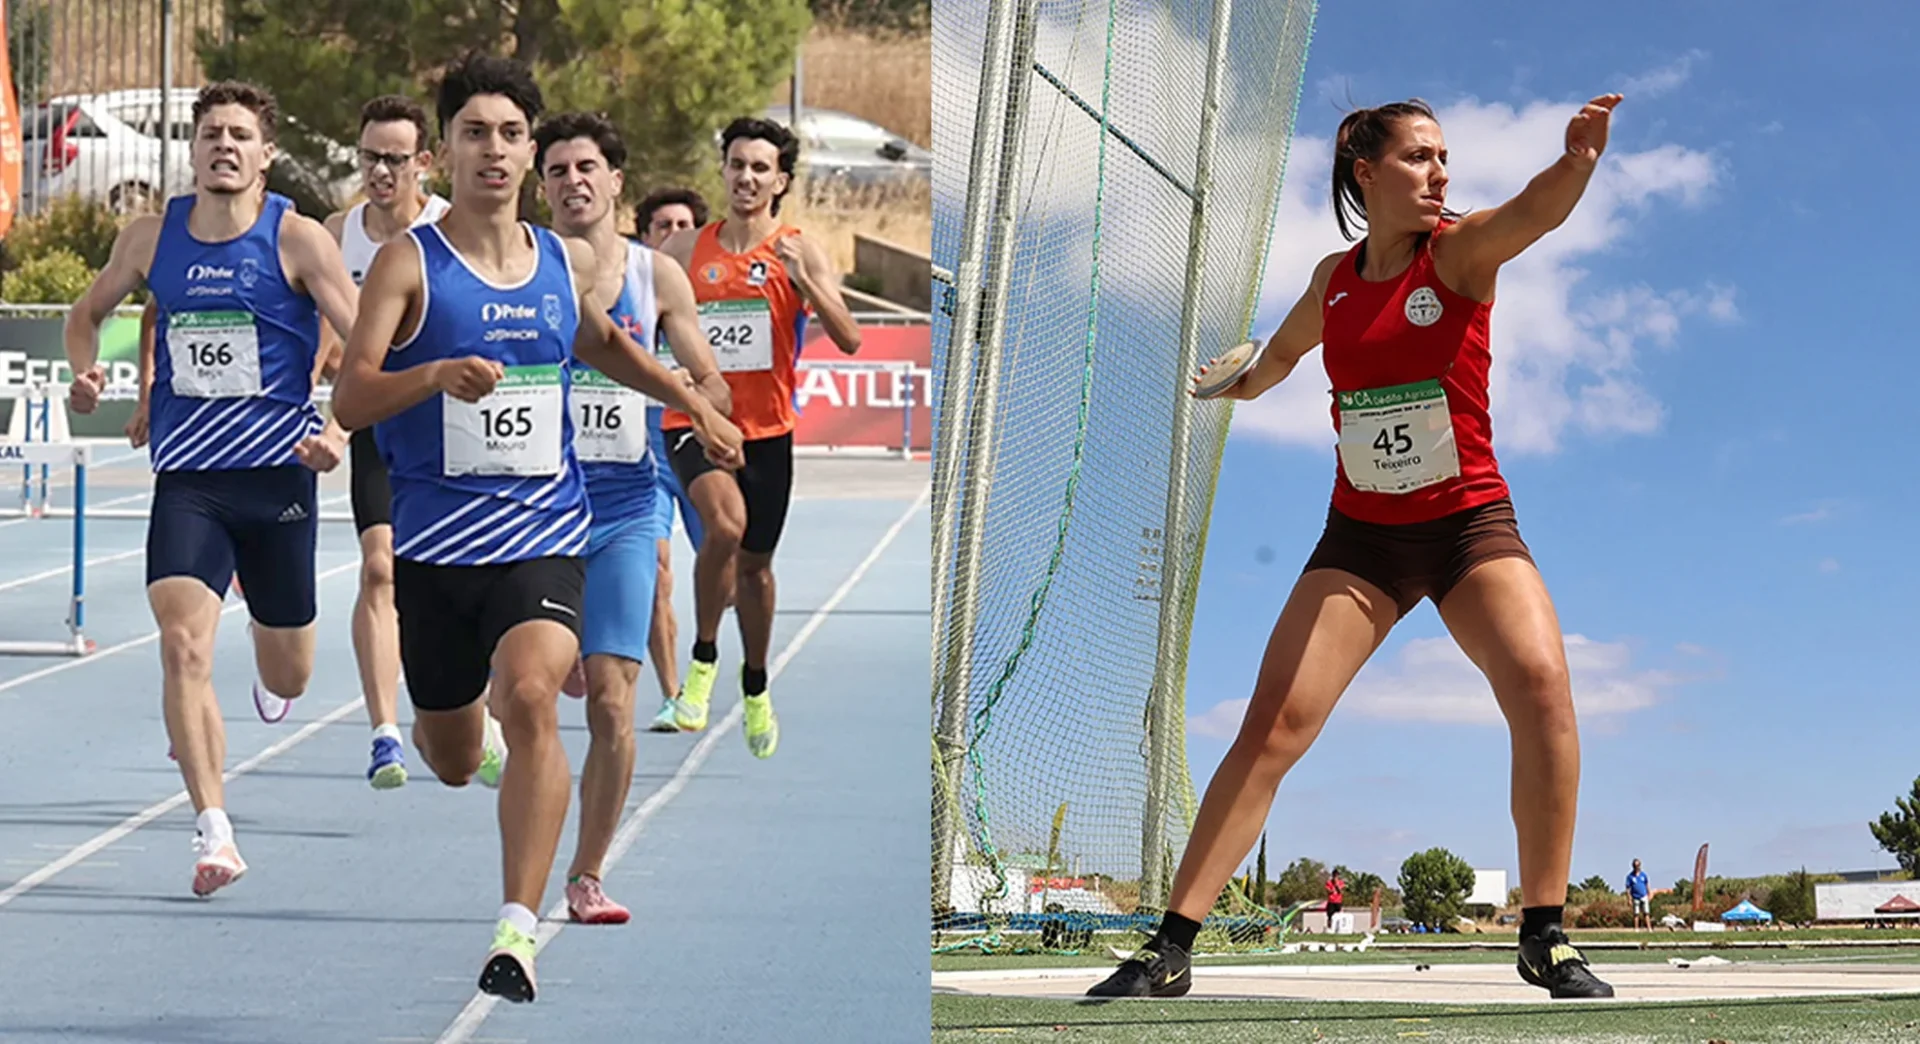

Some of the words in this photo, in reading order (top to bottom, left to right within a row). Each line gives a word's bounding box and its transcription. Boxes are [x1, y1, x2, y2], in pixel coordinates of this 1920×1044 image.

[708, 324, 753, 346] 242
[188, 343, 233, 366] 166
[571, 370, 592, 384] CA
[1354, 390, 1373, 406] CA
[480, 406, 532, 438] 165
[580, 404, 622, 431] 116
[1373, 423, 1413, 456] 45
[1373, 455, 1422, 470] Teixeira
